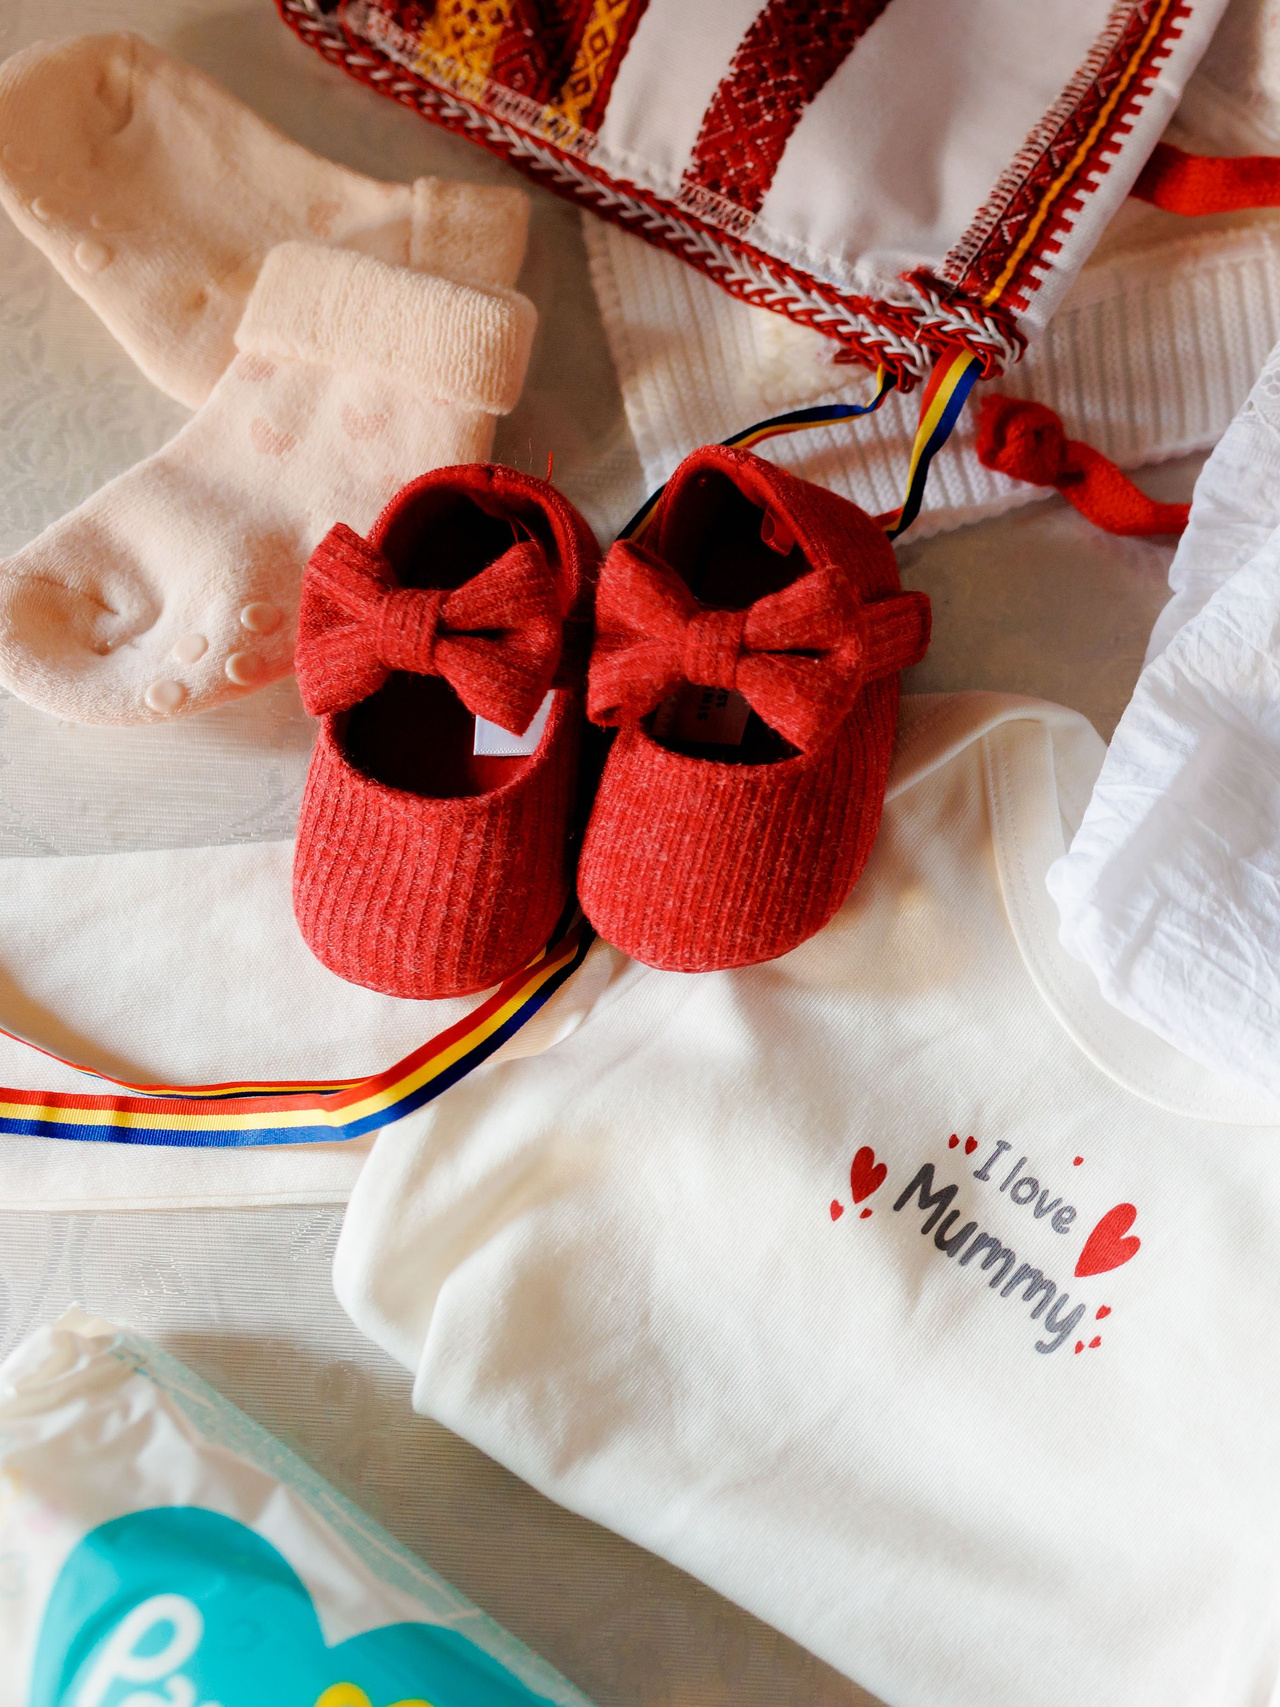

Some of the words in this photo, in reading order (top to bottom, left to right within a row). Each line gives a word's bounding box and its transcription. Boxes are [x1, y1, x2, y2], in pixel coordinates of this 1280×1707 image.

[893, 1163, 1086, 1354] Mummy
[973, 1140, 1012, 1181] I
[1000, 1156, 1077, 1235] love
